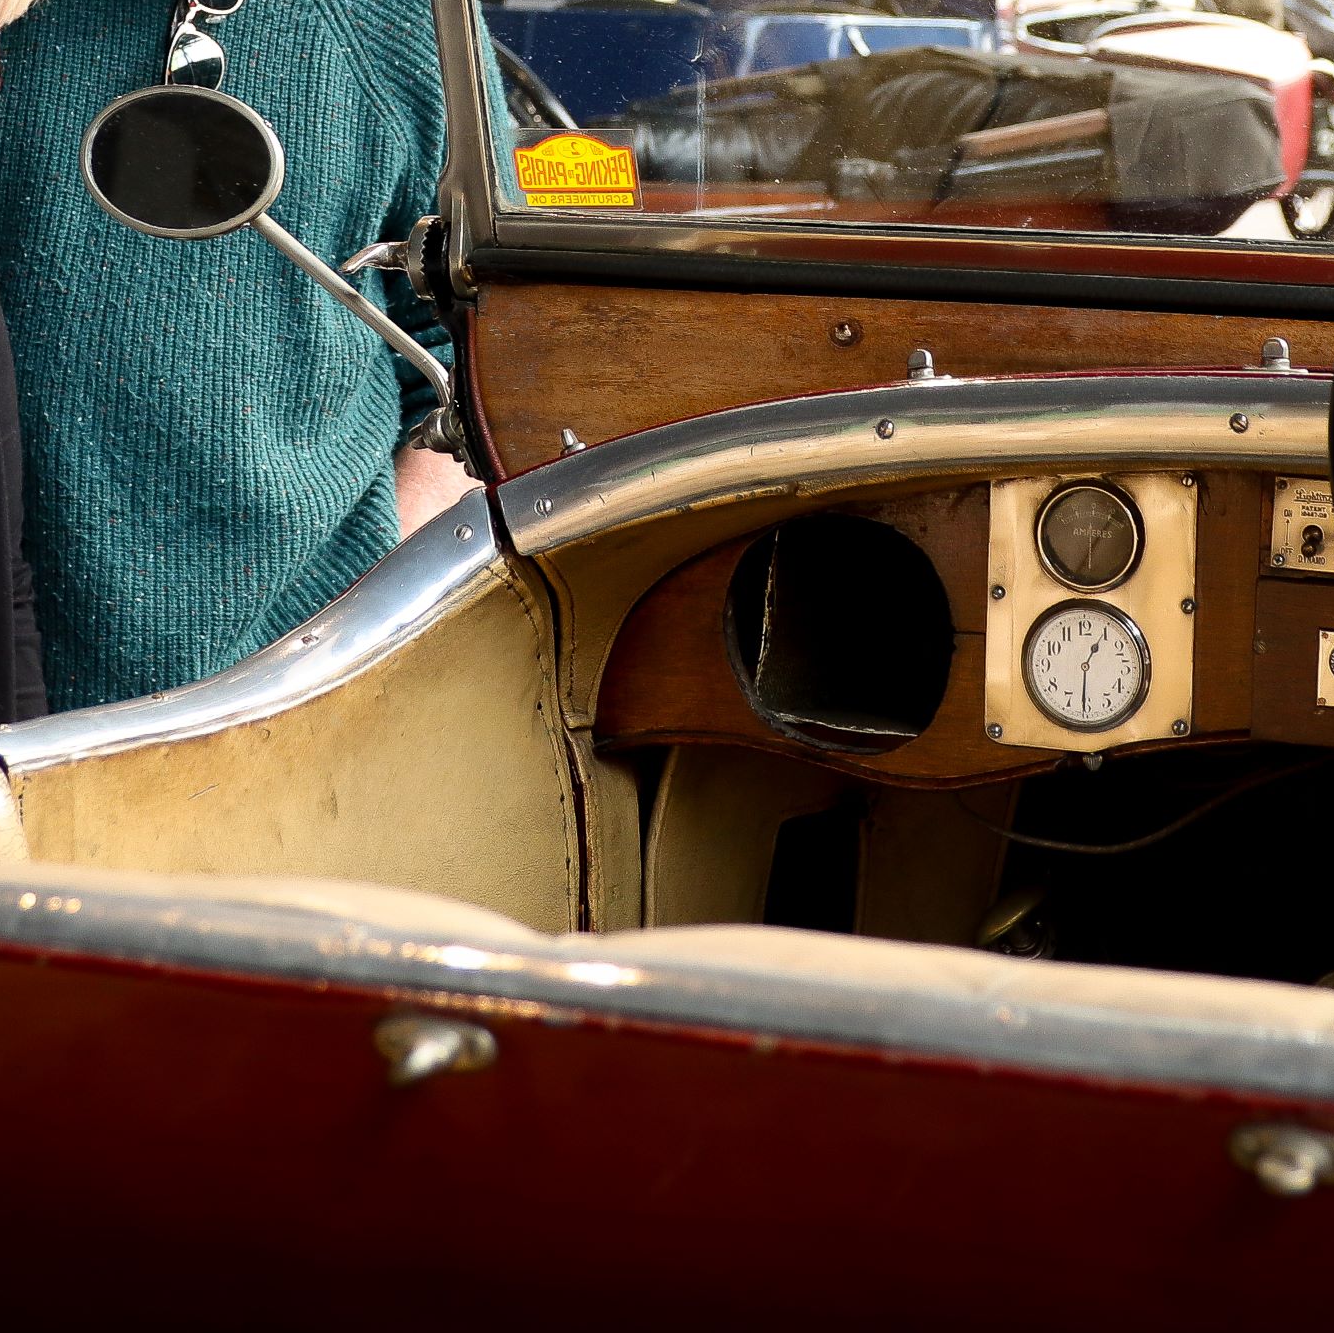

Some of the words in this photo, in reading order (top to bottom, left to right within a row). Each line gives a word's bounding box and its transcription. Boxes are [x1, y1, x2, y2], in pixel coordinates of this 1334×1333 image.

[1284, 509, 1293, 518] ON
[1280, 547, 1294, 555] OFF
[1298, 555, 1326, 565] DYNAMO
[1062, 626, 1071, 642] 11
[1079, 620, 1092, 636] 12
[1103, 627, 1108, 641] 1
[1048, 640, 1061, 656] 10
[1114, 640, 1124, 656] 2
[1041, 658, 1050, 674] 9
[1120, 659, 1131, 676] 3
[1048, 677, 1058, 693] 8
[1112, 678, 1124, 694] 4
[1064, 691, 1073, 707] 7
[1083, 697, 1091, 713] 6
[1102, 692, 1112, 708] 5
